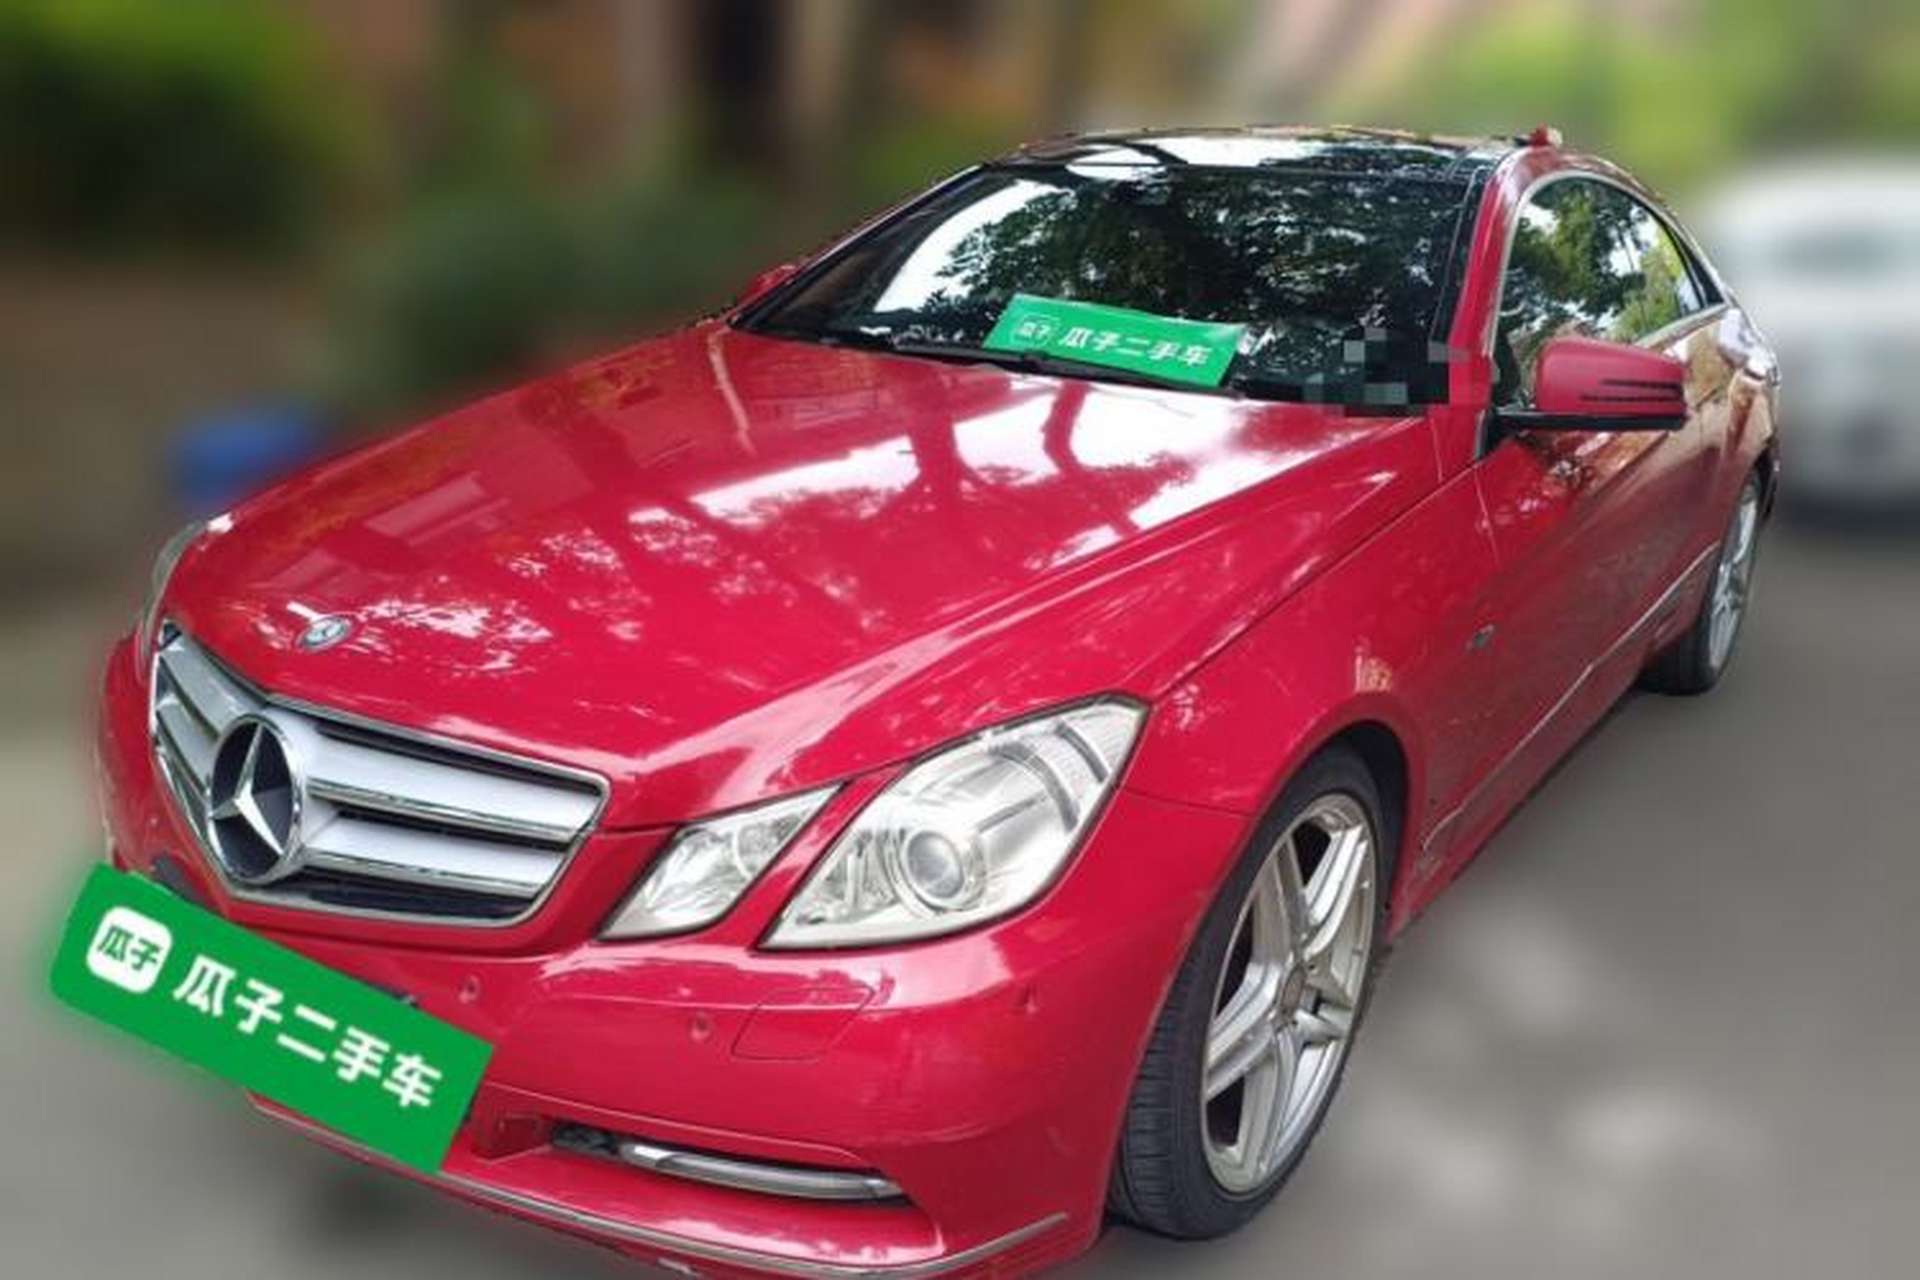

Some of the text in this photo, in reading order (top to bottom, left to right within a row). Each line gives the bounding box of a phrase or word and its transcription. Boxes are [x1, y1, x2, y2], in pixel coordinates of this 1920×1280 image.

[1059, 326, 1212, 366] 瓜子二手车
